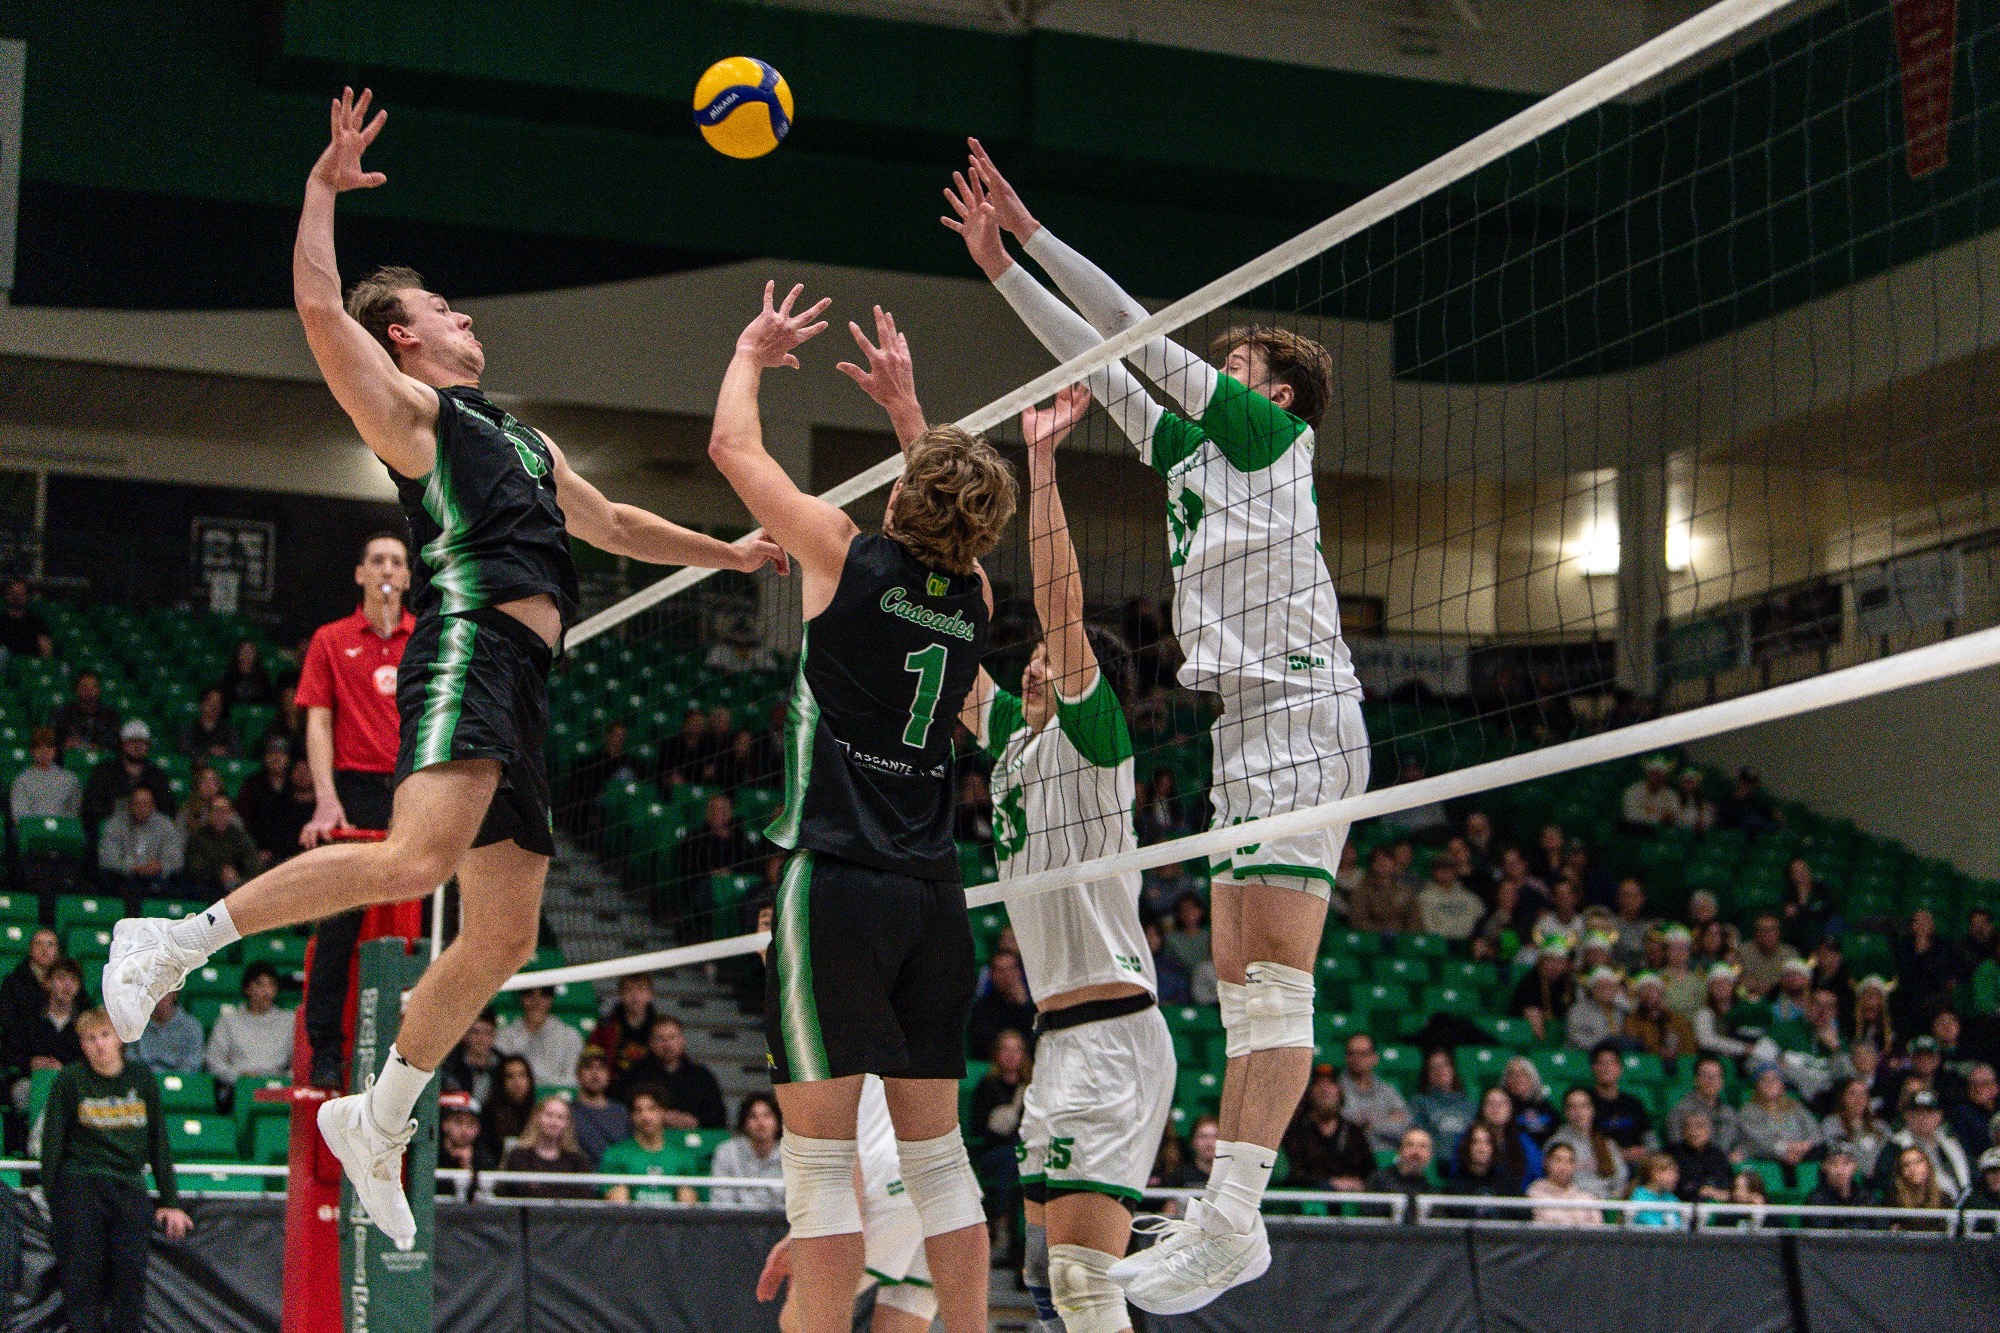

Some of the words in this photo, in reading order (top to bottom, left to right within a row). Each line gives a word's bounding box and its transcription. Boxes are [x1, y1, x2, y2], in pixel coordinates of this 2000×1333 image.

[709, 92, 740, 121] MIKASA
[880, 586, 975, 642] Cascades
[902, 643, 948, 750] 1
